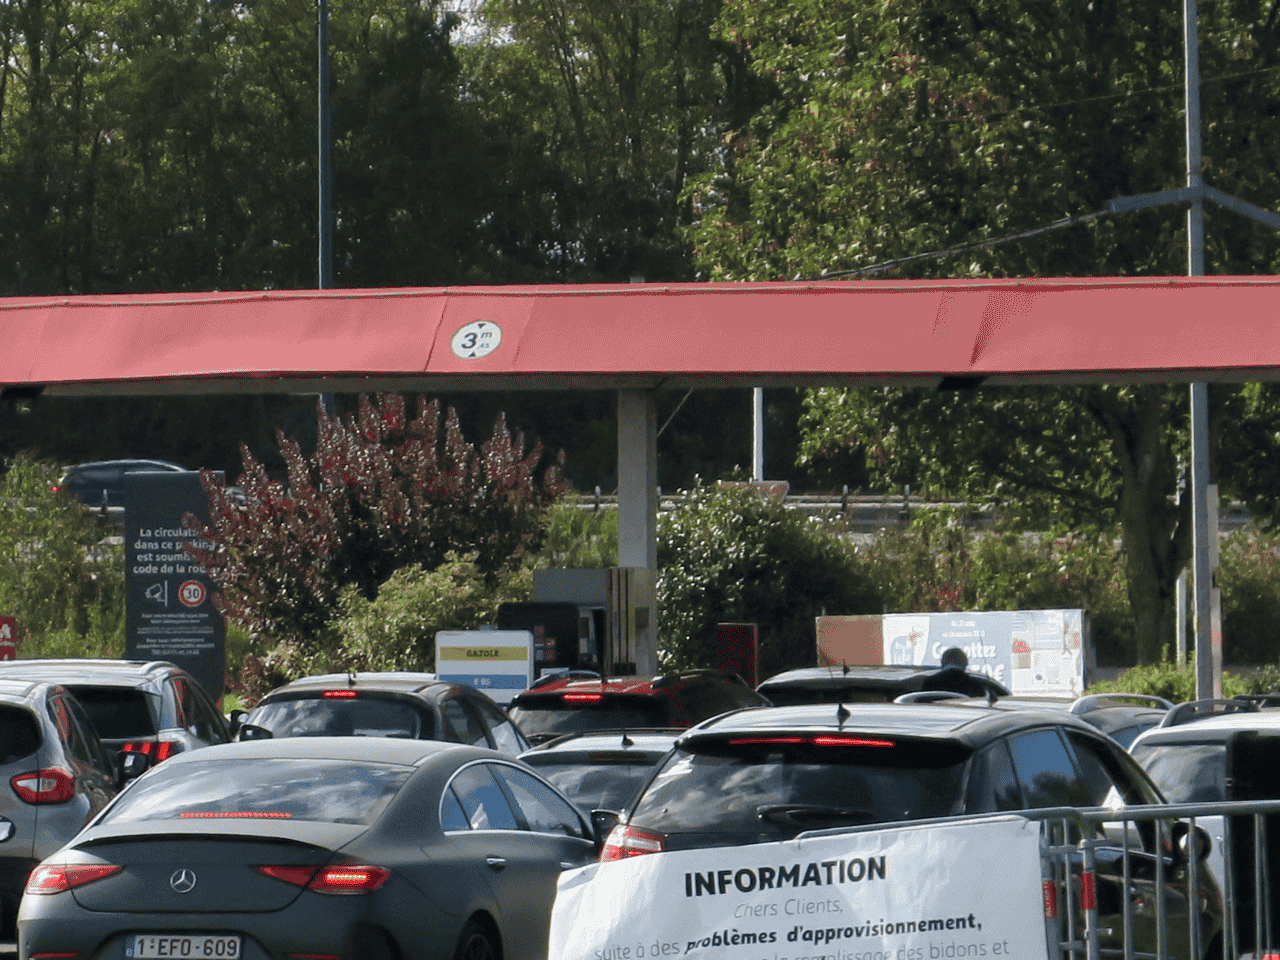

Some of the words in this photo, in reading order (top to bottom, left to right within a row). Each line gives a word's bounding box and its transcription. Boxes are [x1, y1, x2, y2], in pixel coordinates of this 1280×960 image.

[461, 332, 478, 349] 3
[140, 527, 153, 537] La
[134, 539, 160, 550] dans
[161, 541, 174, 550] ce
[137, 553, 153, 562] est
[133, 563, 159, 574] code
[160, 563, 174, 574] de
[177, 563, 186, 574] la
[186, 588, 200, 600] 30
[466, 649, 500, 657] GAZOLE
[684, 854, 888, 898] INFORMATION
[733, 900, 779, 919] Chers
[784, 897, 845, 916] Clients,
[635, 944, 645, 959] à
[650, 940, 681, 959] des
[684, 926, 778, 956] problèmes
[928, 940, 988, 960] bidons
[992, 939, 1010, 956] et
